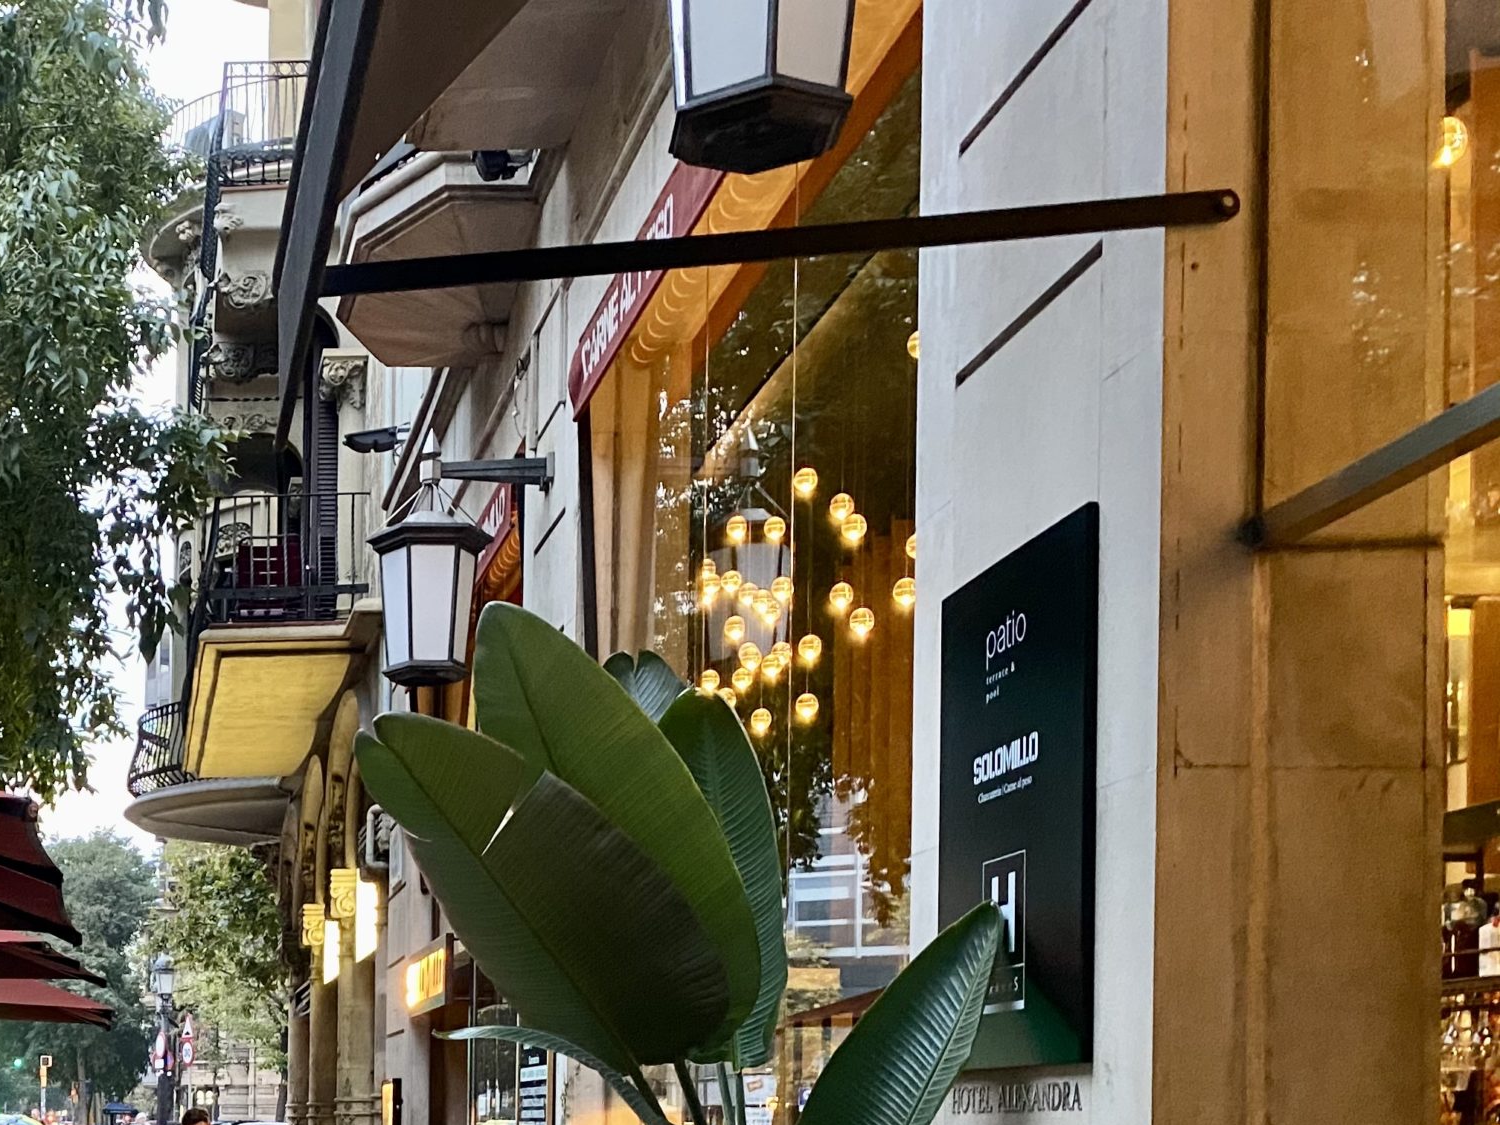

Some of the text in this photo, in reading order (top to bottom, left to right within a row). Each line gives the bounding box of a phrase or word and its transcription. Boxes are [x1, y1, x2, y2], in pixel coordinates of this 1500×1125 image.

[581, 288, 619, 383] CARNE
[620, 271, 637, 322] AL
[986, 609, 1027, 671] patio
[986, 667, 1009, 685] terrace
[986, 685, 1000, 704] pool
[973, 731, 1039, 785] SOLOMILLO
[952, 1081, 1082, 1115] HOTEL ALEXANDRA
